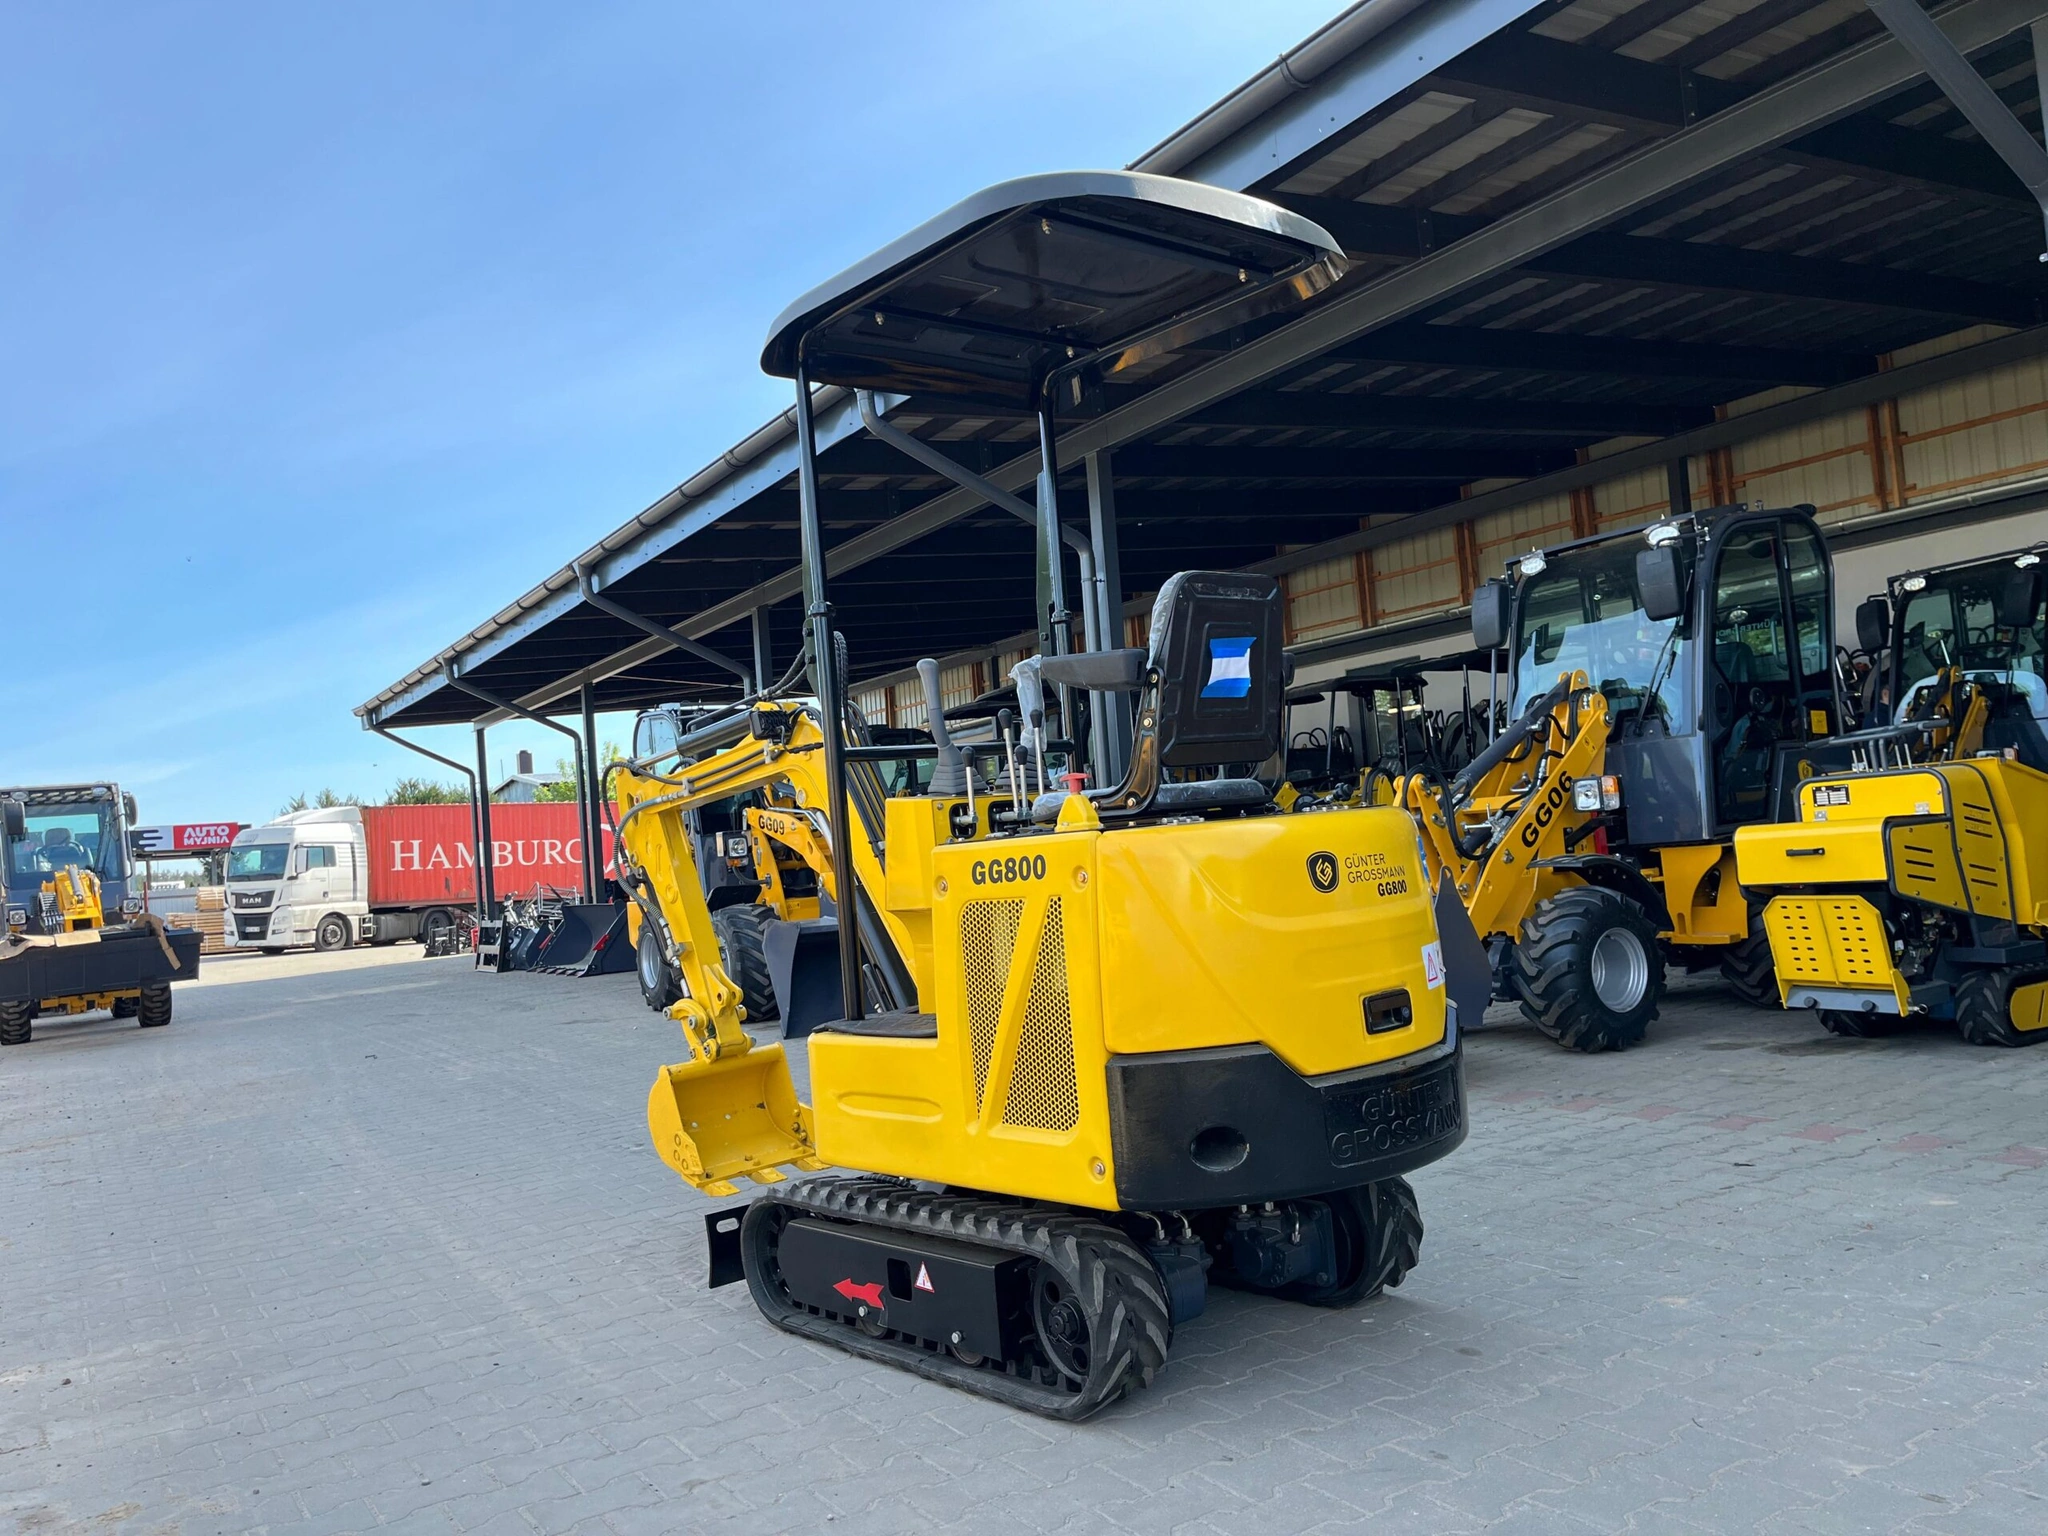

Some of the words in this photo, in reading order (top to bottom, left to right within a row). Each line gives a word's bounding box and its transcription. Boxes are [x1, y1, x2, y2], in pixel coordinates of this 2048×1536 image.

[1521, 770, 1573, 848] GG06
[183, 825, 229, 838] AUTO
[758, 814, 785, 835] GG09
[183, 835, 230, 846] MYJNIA
[971, 854, 1046, 885] GG800
[1344, 853, 1386, 869] GÜNTER
[1347, 865, 1405, 884] GROSSMANN
[1377, 879, 1407, 897] GG800
[1361, 1079, 1440, 1121] GÜNTER
